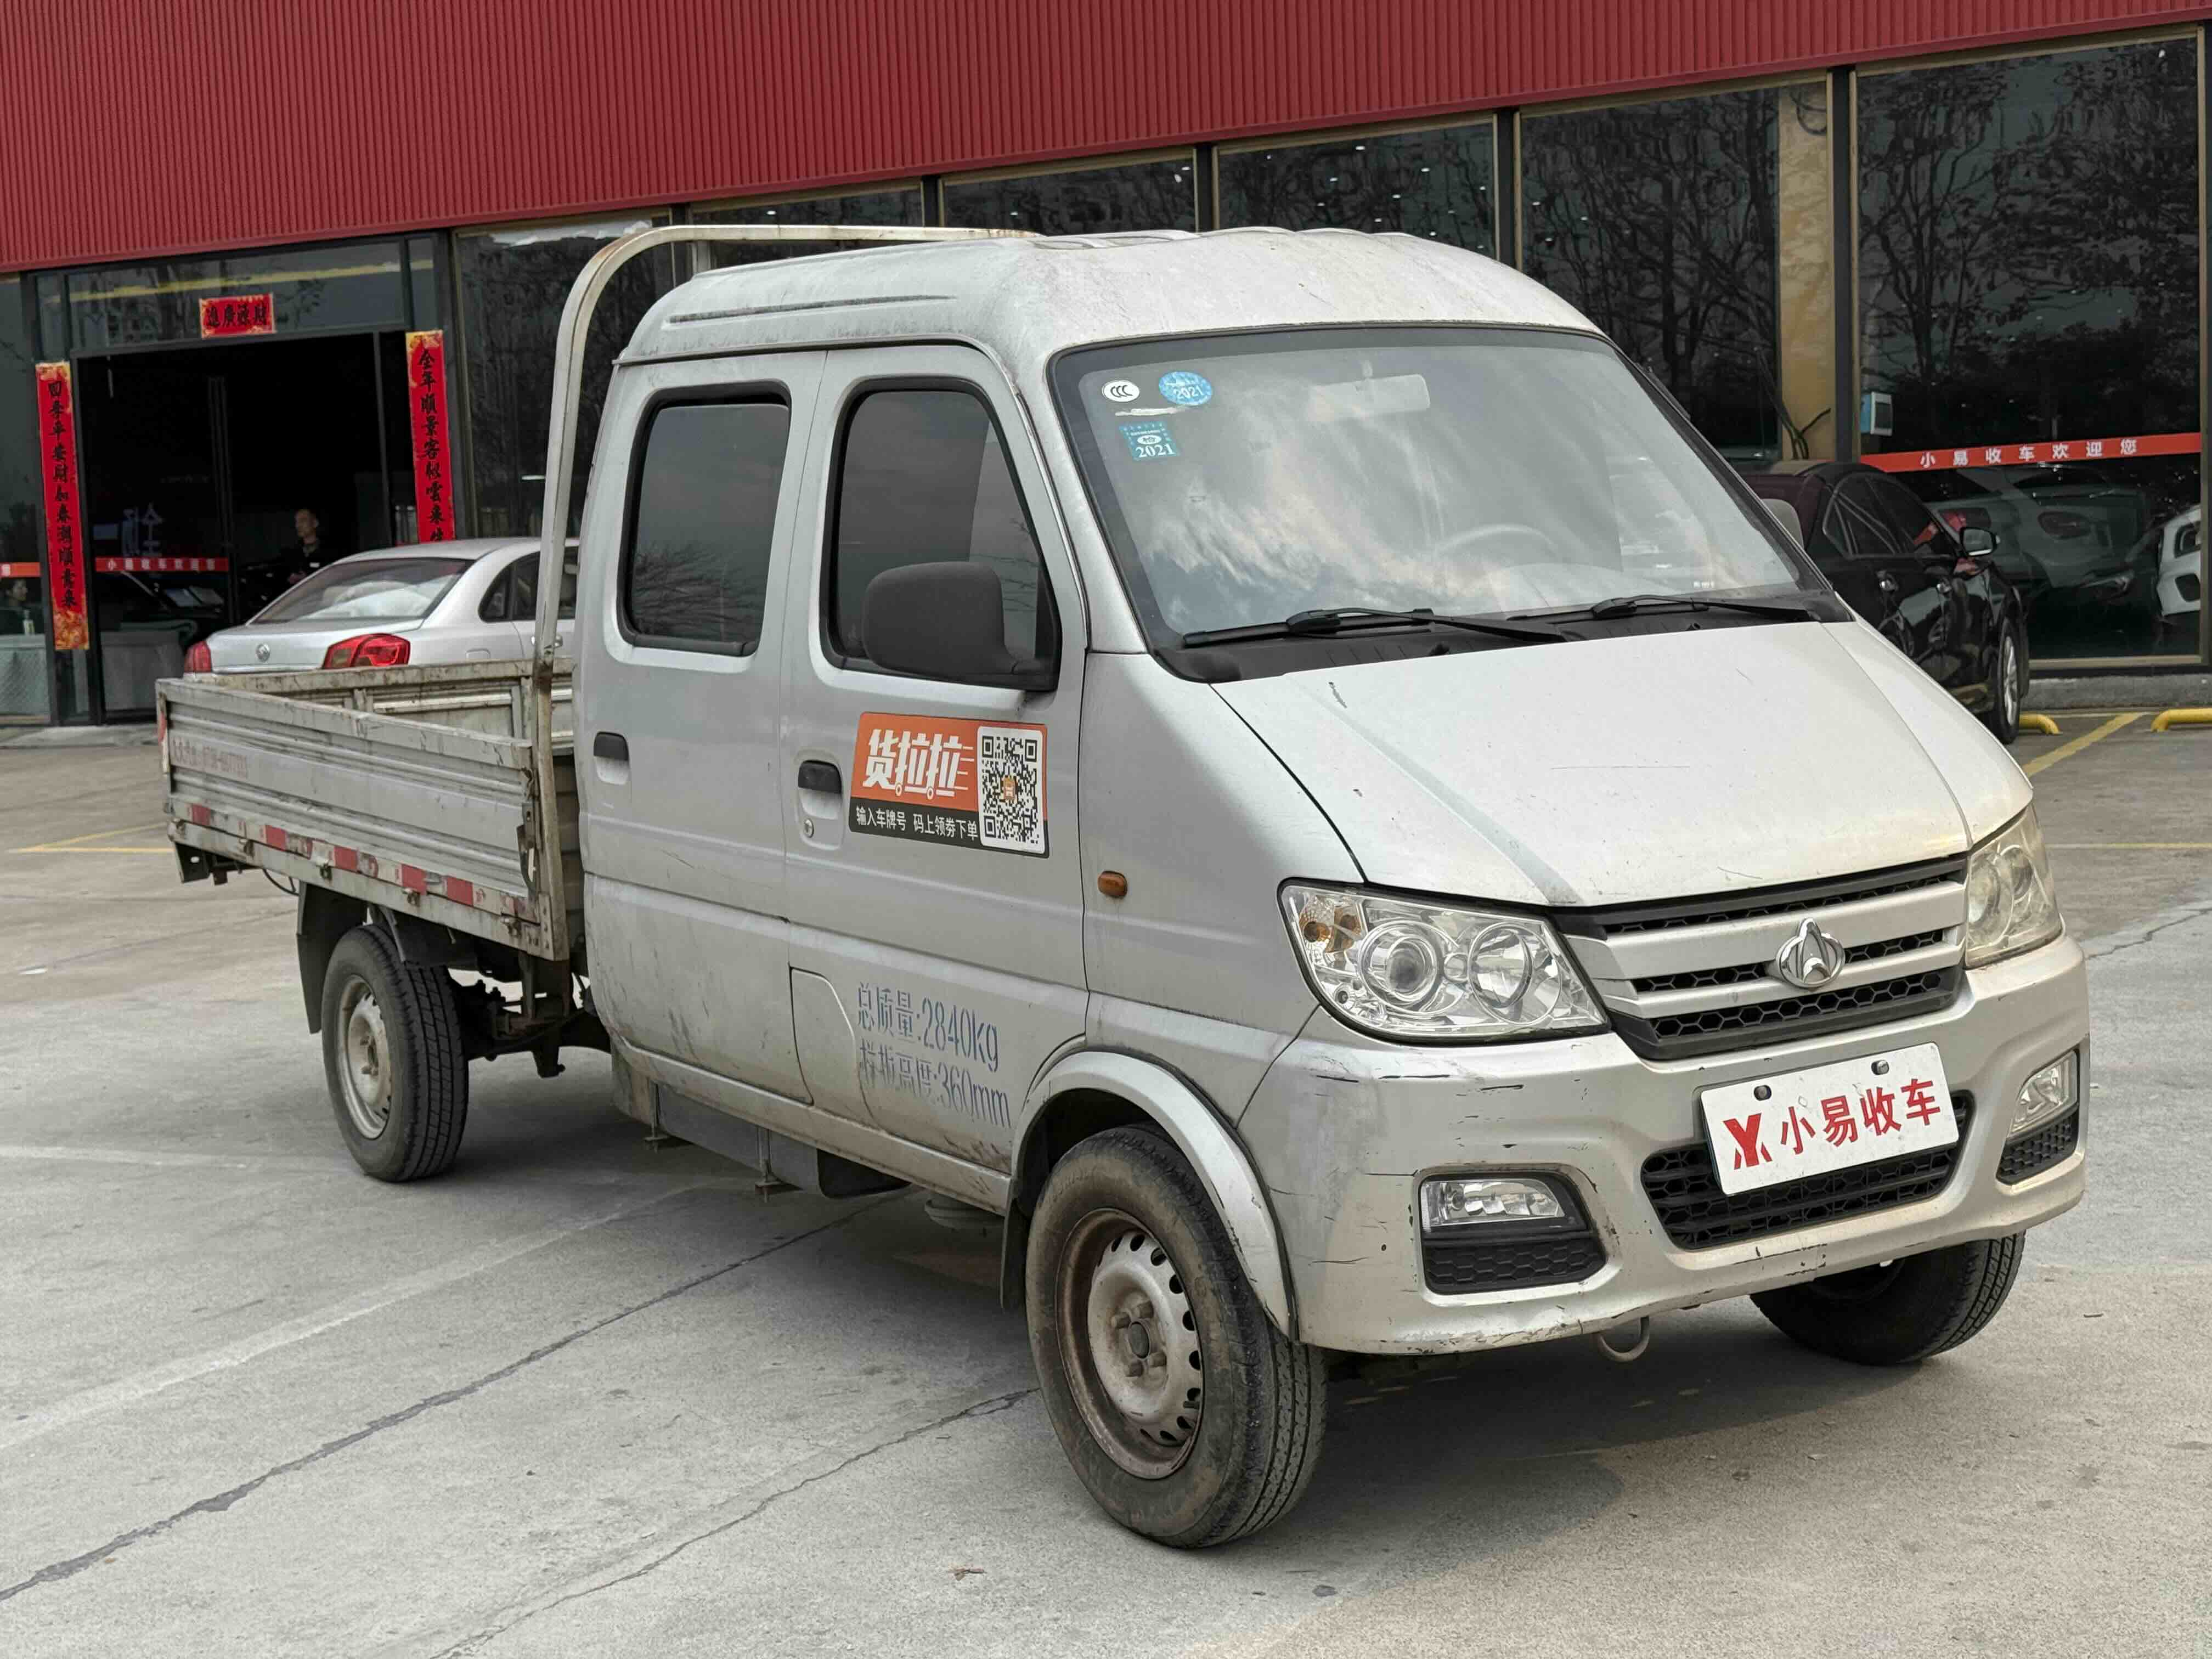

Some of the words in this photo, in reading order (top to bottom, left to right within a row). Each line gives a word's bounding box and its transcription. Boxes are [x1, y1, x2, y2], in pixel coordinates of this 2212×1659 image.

[1173, 385, 1203, 399] 2021
[1136, 443, 1175, 458] 2021
[1920, 438, 2137, 469] 小易收车欢迎您
[862, 728, 963, 799] 货拉拉
[856, 805, 906, 831] 输入车牌号
[913, 813, 978, 841] 码上领券下单
[1781, 1079, 1940, 1155] 小易收车
